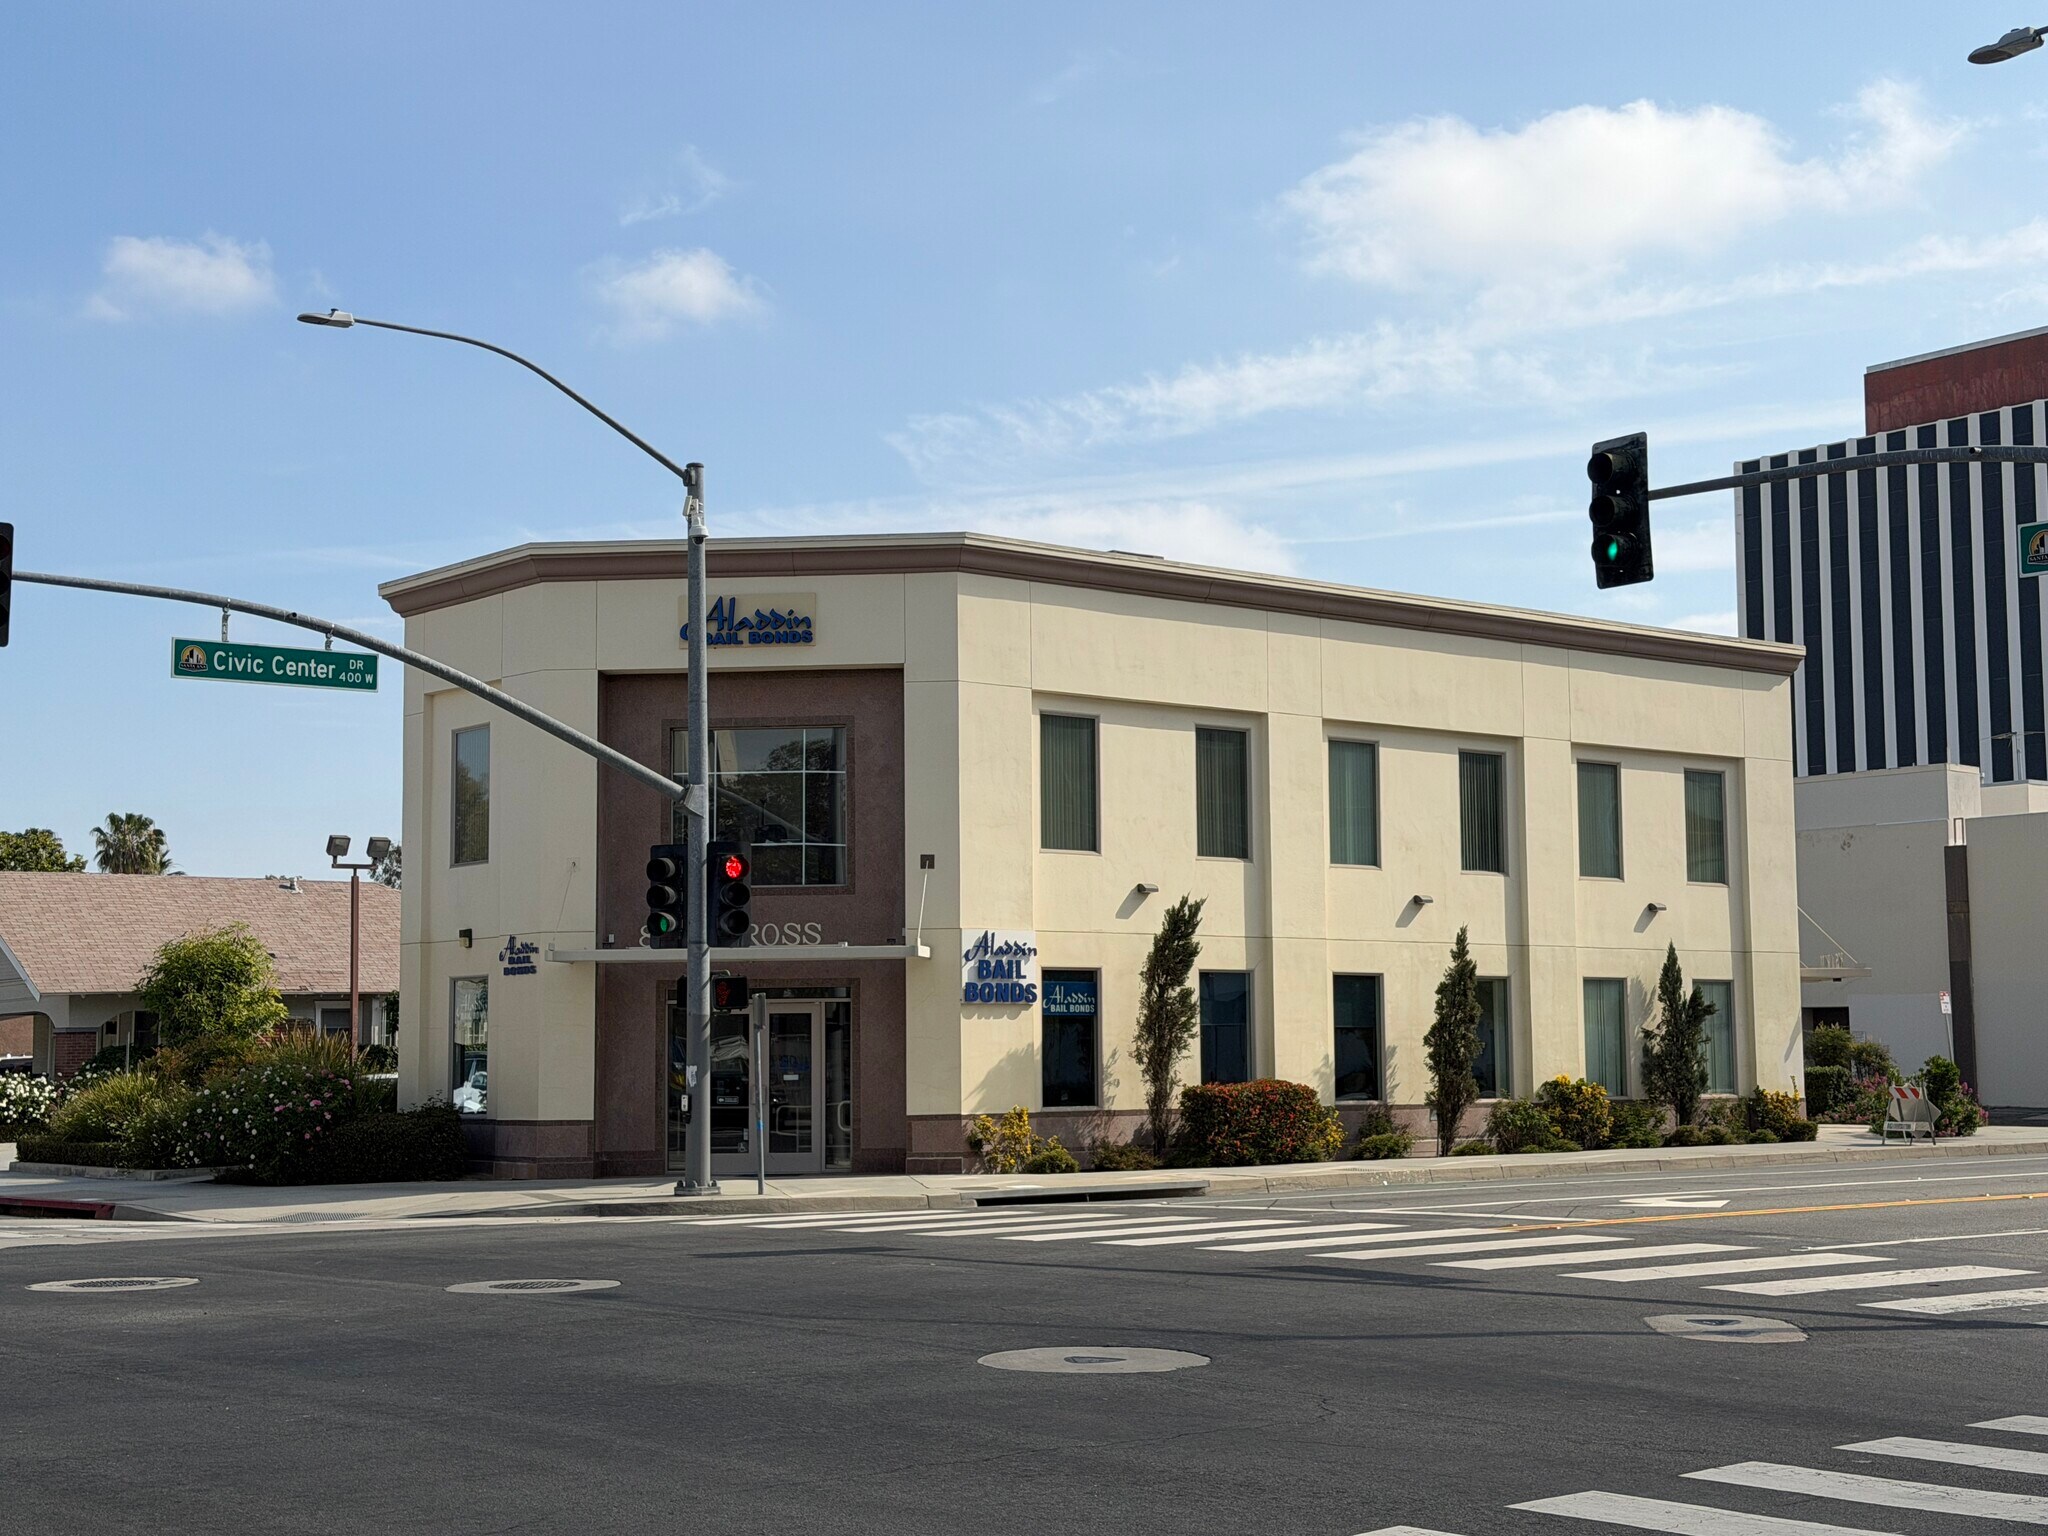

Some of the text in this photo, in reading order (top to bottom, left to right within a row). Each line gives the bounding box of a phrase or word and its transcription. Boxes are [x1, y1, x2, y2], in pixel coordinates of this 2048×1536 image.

[680, 595, 812, 641] Aladdin
[749, 630, 813, 644] BONDS
[214, 651, 364, 679] Civic Center DR
[339, 672, 374, 684] 400 W
[499, 934, 539, 961] Aladdin
[964, 930, 1037, 961] Aladdin
[977, 959, 1026, 980] BAIL
[964, 982, 1037, 1003] BONDS
[1043, 985, 1096, 1008] Aladdin
[1050, 1004, 1095, 1013] BAIL BONDS
